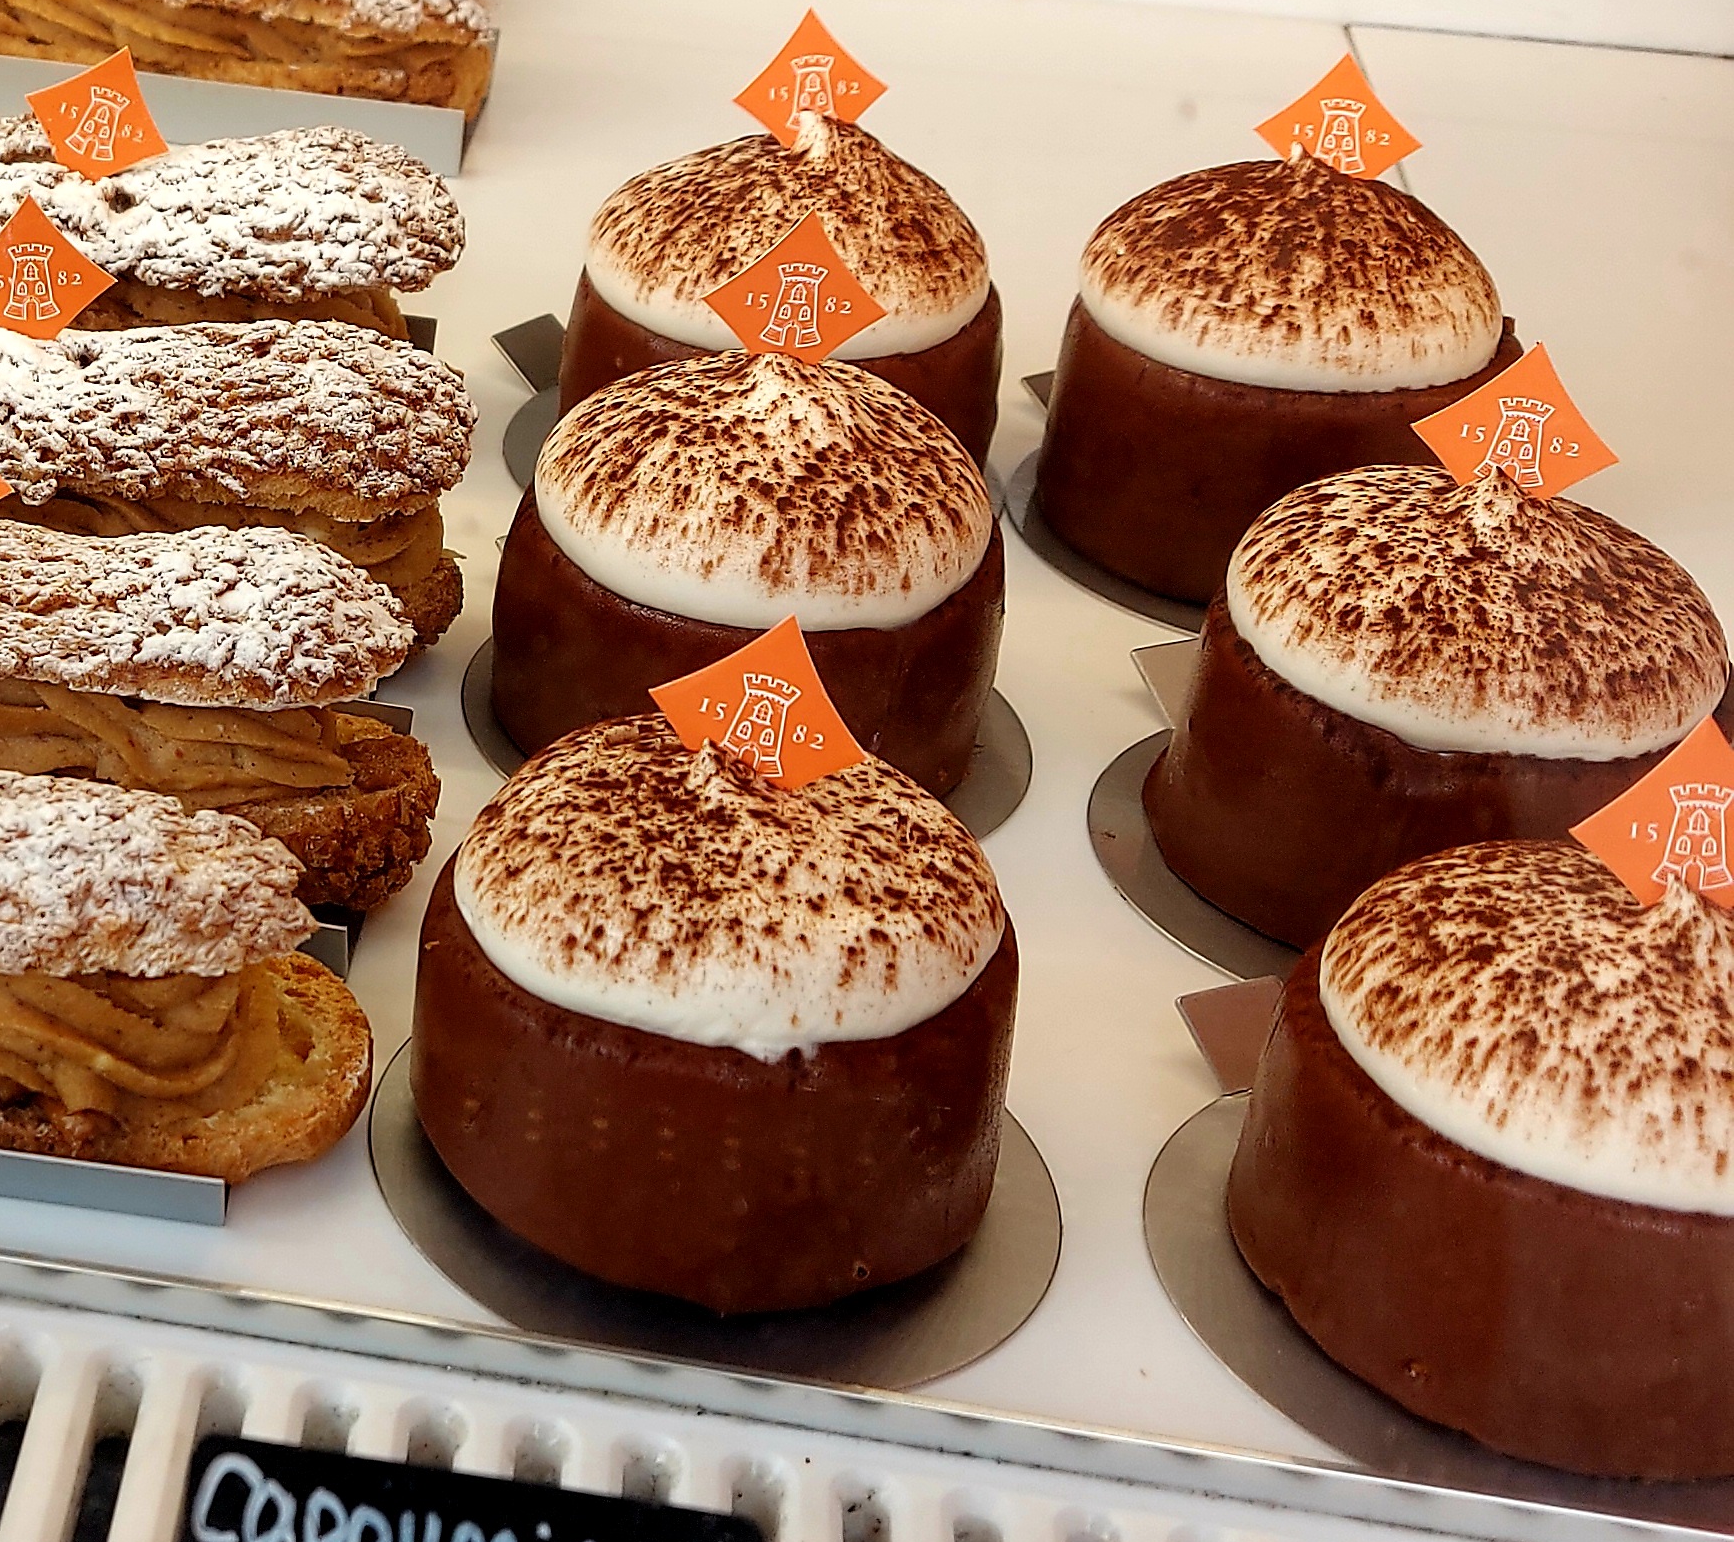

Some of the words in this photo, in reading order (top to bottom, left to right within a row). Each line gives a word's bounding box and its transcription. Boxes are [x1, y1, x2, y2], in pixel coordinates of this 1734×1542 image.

[767, 85, 789, 103] 15
[836, 78, 861, 98] 82
[59, 100, 79, 118] 15
[120, 125, 143, 143] 82
[1292, 123, 1315, 140] 15
[1365, 129, 1392, 145] 82
[57, 270, 83, 287] 82
[744, 290, 769, 310] 15
[824, 296, 853, 315] 82
[1459, 422, 1487, 445] 15
[1548, 433, 1581, 457] 82
[697, 695, 726, 721] 15
[791, 725, 826, 750] 82
[1629, 821, 1659, 842] 15
